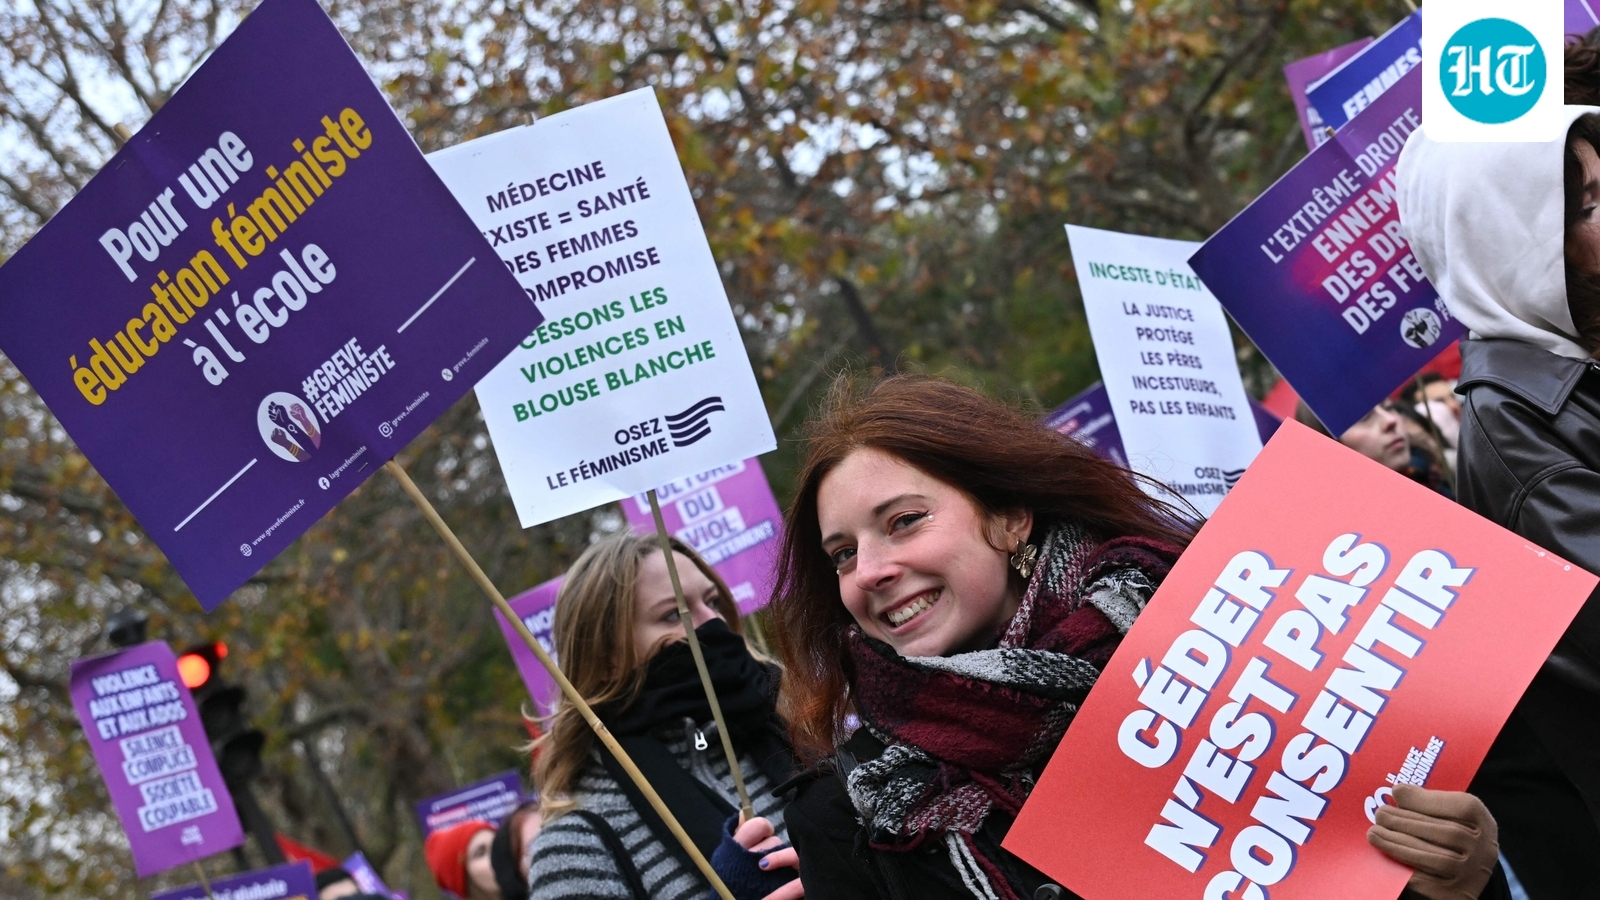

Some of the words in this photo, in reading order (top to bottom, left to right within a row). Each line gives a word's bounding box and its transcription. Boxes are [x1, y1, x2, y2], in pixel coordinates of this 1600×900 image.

[99, 187, 189, 283] Pour
[177, 130, 255, 211] une
[485, 160, 606, 213] MÉDECINE
[576, 176, 651, 218] SANTÉ
[1260, 107, 1419, 264] L'EXTRÊME-DROITE
[69, 250, 231, 406] éducation
[210, 107, 374, 270] féministe
[545, 219, 639, 264] FEMMES
[628, 286, 668, 313] LES
[1089, 261, 1153, 285] INCESTE
[1155, 267, 1202, 292] D'ÉTAT
[1322, 250, 1377, 304] DES
[202, 242, 338, 364] l'école
[1122, 301, 1141, 316] LA
[1144, 304, 1194, 322] JUSTICE
[1341, 282, 1397, 335] DES
[519, 327, 650, 384] VIOLENCES
[653, 315, 687, 340] EN
[1136, 326, 1194, 345] PROTÈGE
[182, 337, 224, 386] à
[301, 336, 367, 404] #GREVE
[512, 377, 601, 423] BLOUSE
[604, 340, 716, 392] BLANCHE
[1140, 351, 1164, 366] LES
[1166, 349, 1202, 370] PÈRES
[313, 344, 397, 424] FEMINISTE
[1132, 376, 1222, 398] INCESTUEURS,
[390, 390, 431, 428] greve_feministe
[614, 417, 663, 445] OSEZ
[1129, 400, 1156, 415] PAS
[1159, 400, 1182, 416] LES
[1186, 401, 1236, 420] ENFANTS
[328, 444, 368, 481] lagrevefeministe
[546, 471, 569, 491] LE
[568, 437, 670, 484] FÉMINISME
[251, 497, 306, 548] www.grevefeministe.fr
[683, 491, 716, 519] DU
[685, 516, 738, 548] VIOL
[91, 664, 161, 697] VIOLENCE
[1117, 549, 1294, 769] CÉDER
[1144, 655, 1301, 874] N'EST
[1261, 532, 1392, 673] PAS
[1385, 772, 1397, 784] LA
